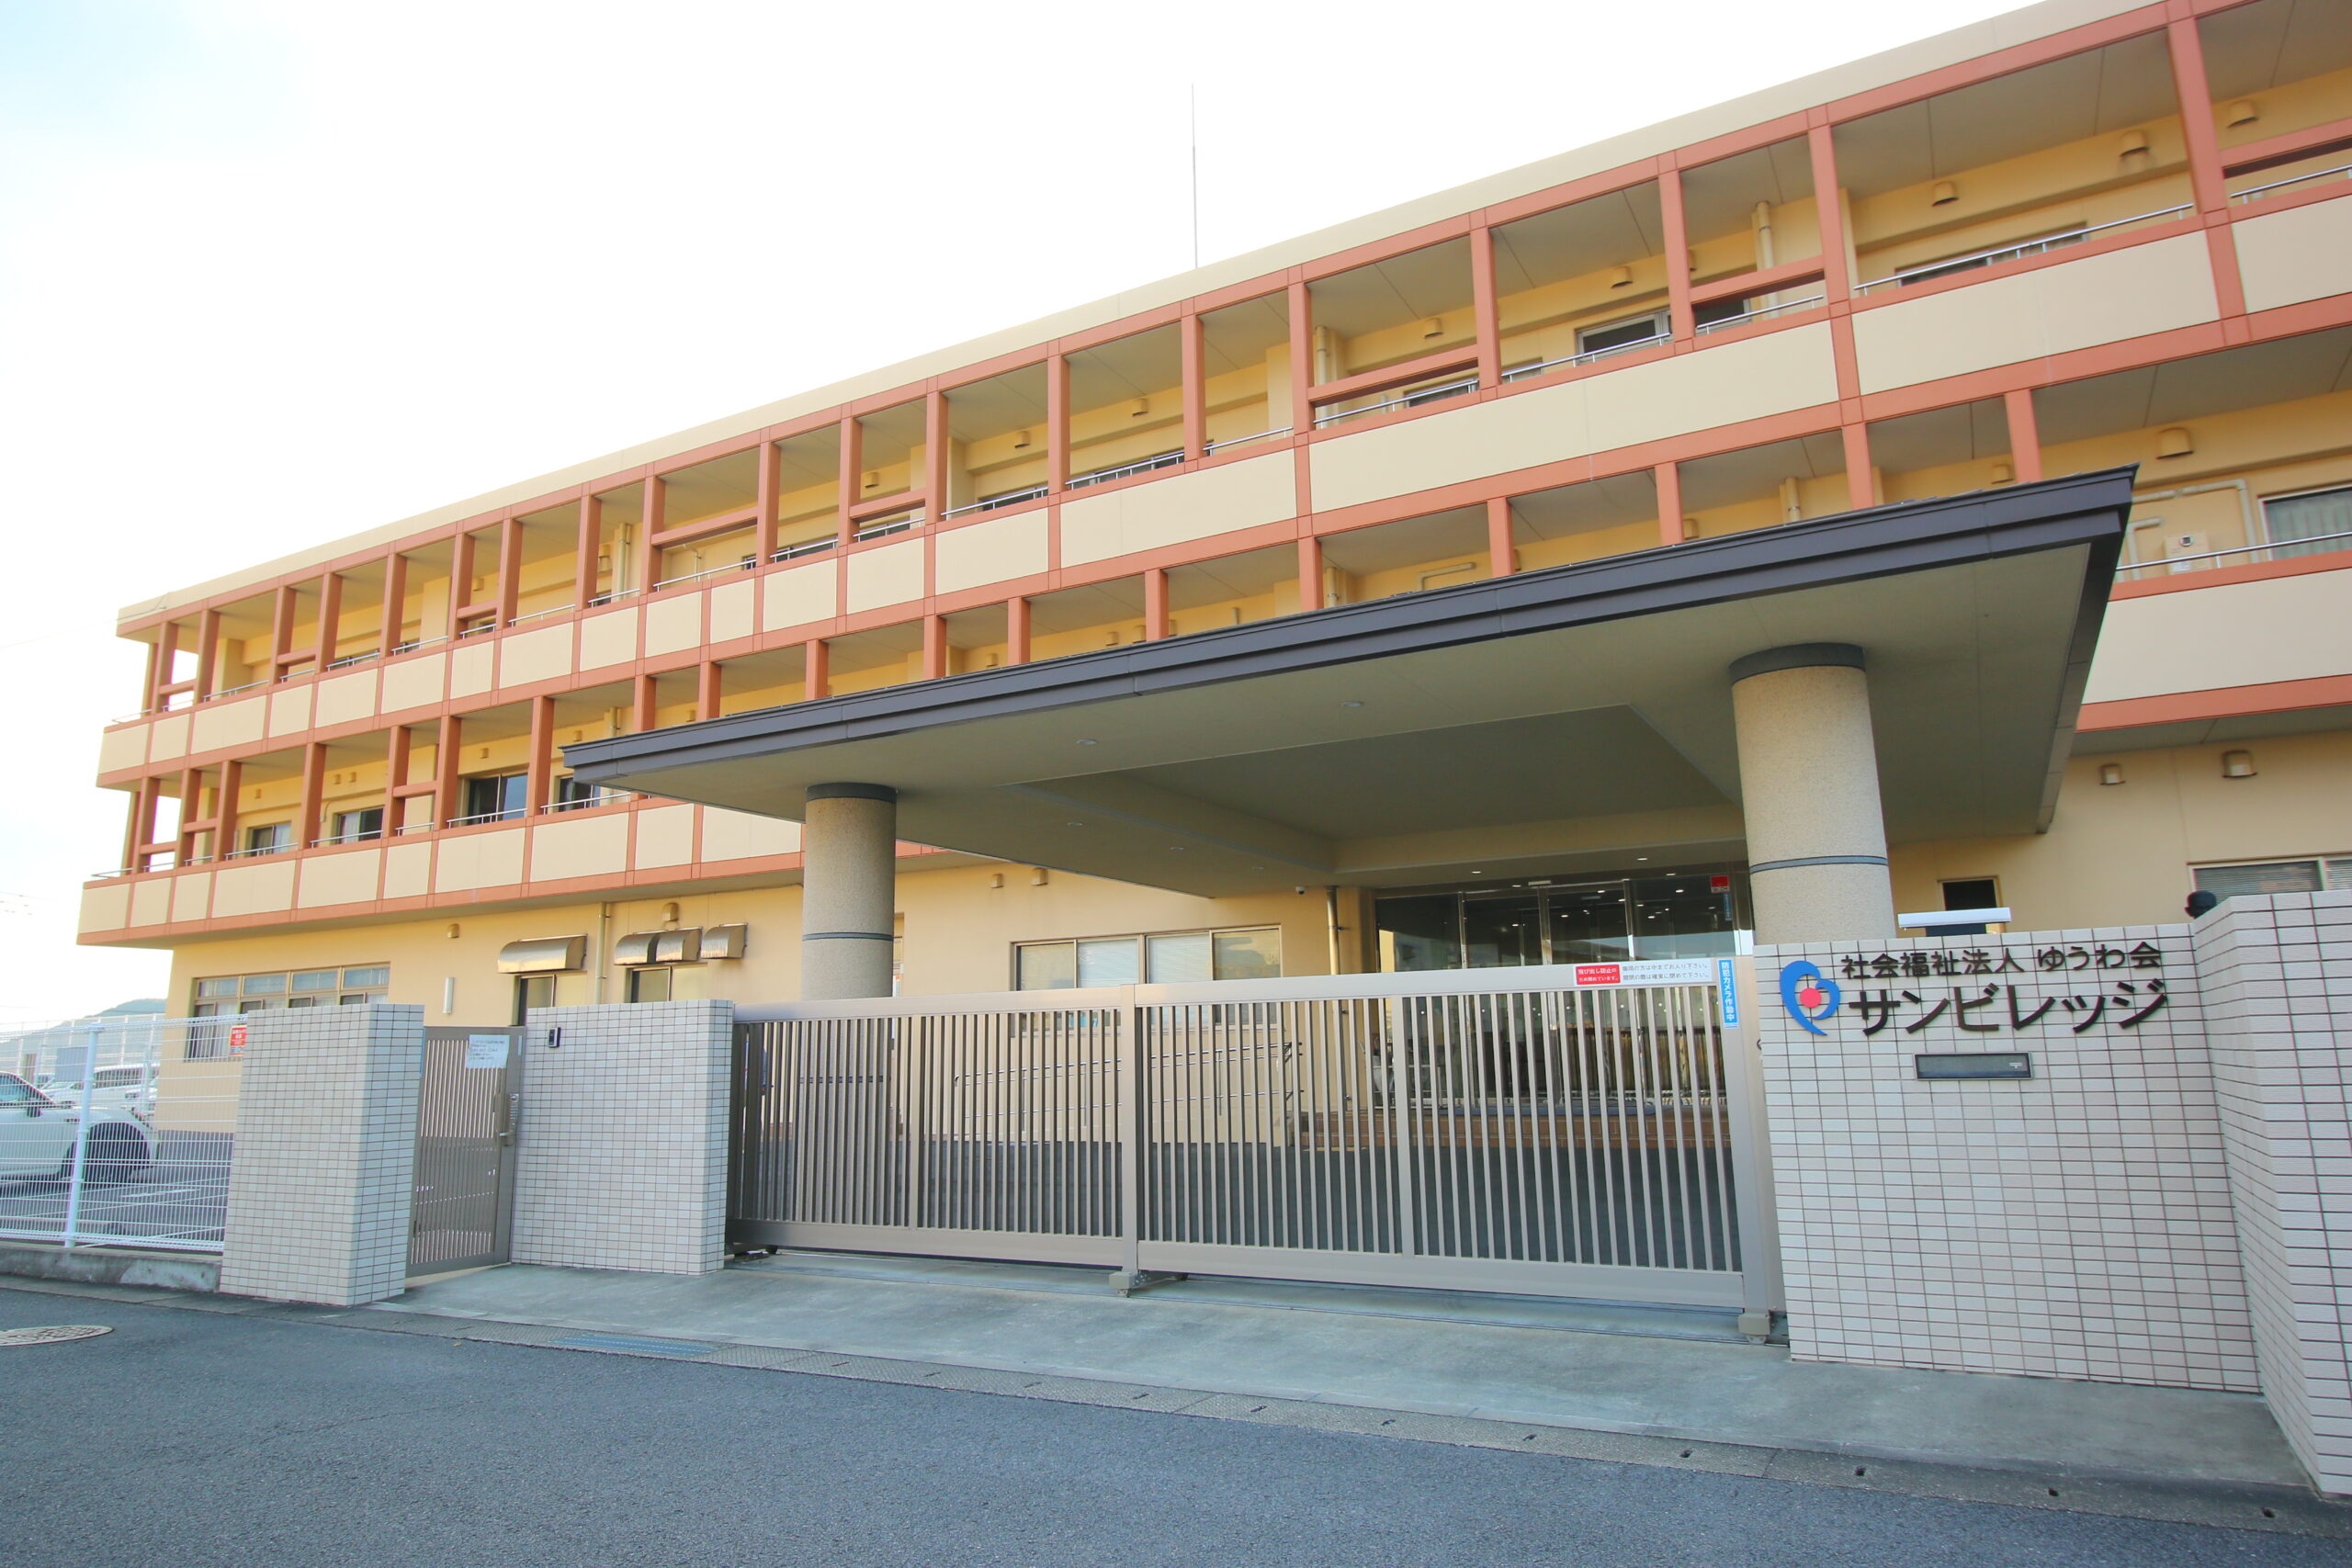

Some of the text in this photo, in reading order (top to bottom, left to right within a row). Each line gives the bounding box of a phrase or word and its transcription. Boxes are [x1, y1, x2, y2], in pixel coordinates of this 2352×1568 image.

[1840, 942, 2162, 979] 社会福祉法人 ゆうわ会
[1849, 978, 2167, 1036] サンビレッジ
